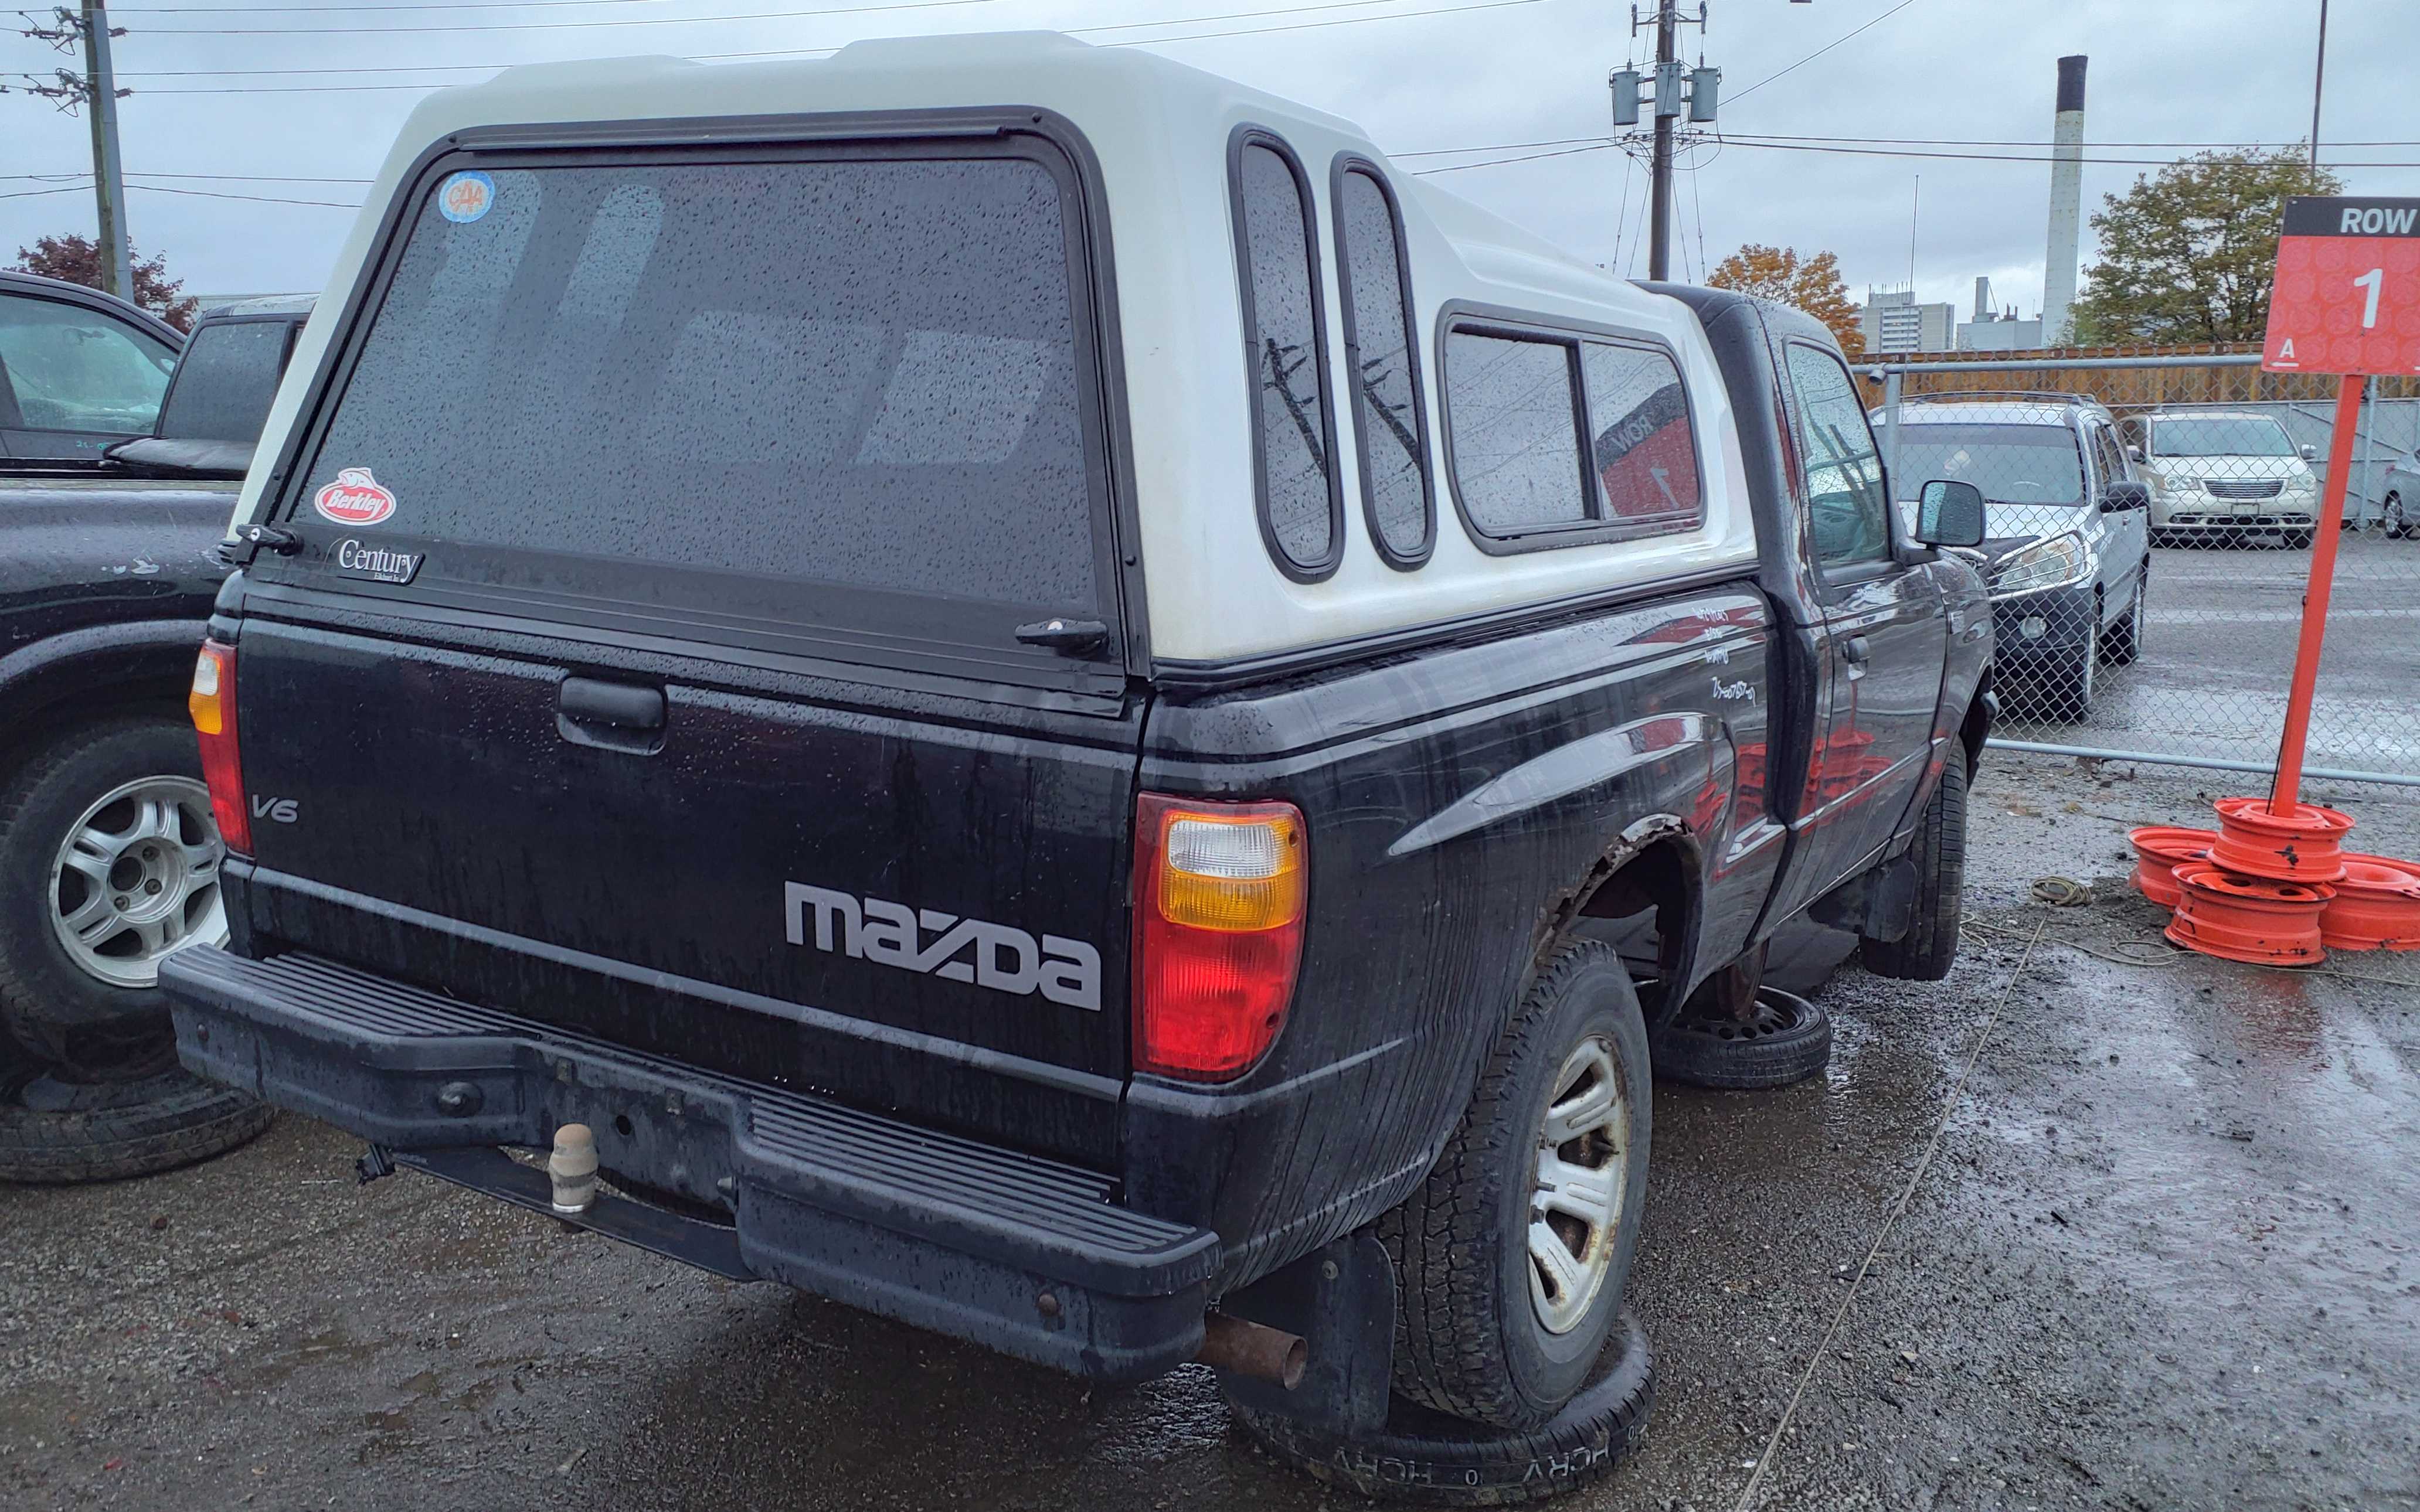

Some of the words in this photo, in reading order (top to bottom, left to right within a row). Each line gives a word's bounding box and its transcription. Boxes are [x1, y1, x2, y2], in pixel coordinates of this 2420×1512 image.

[2340, 207, 2418, 234] ROW
[2354, 268, 2383, 329] 1
[2279, 338, 2295, 359] A
[325, 489, 386, 520] Berkley
[339, 539, 419, 583] Century
[252, 794, 299, 823] V6
[784, 880, 1102, 1012] mazda
